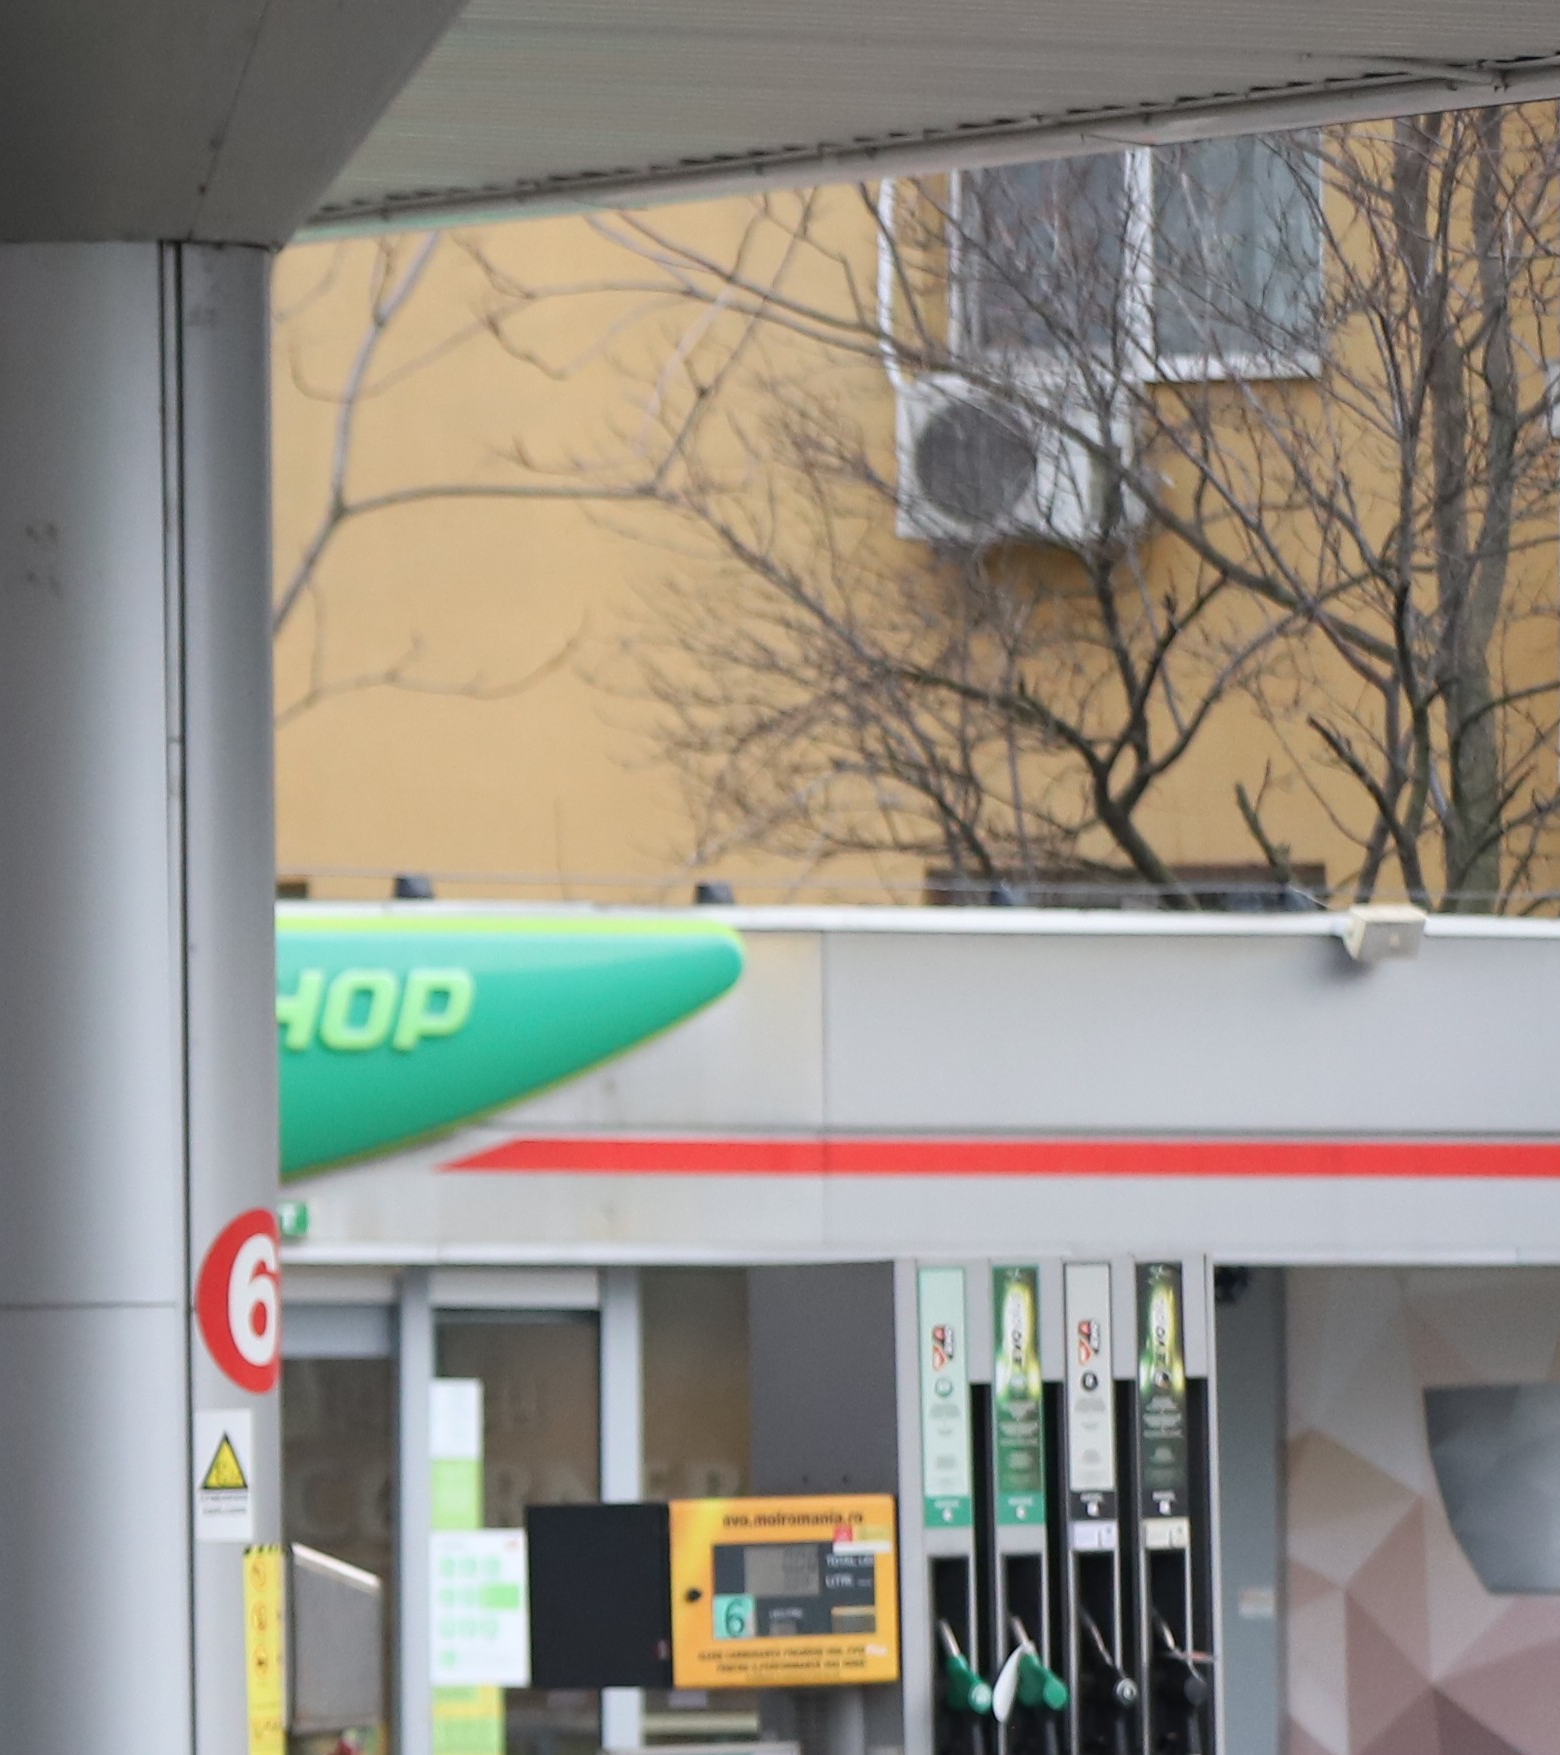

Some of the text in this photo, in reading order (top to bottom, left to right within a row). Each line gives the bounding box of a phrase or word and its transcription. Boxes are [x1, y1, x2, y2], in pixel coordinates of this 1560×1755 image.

[277, 967, 475, 1052] HOP
[227, 1231, 278, 1368] 6
[725, 1597, 745, 1638] 6
